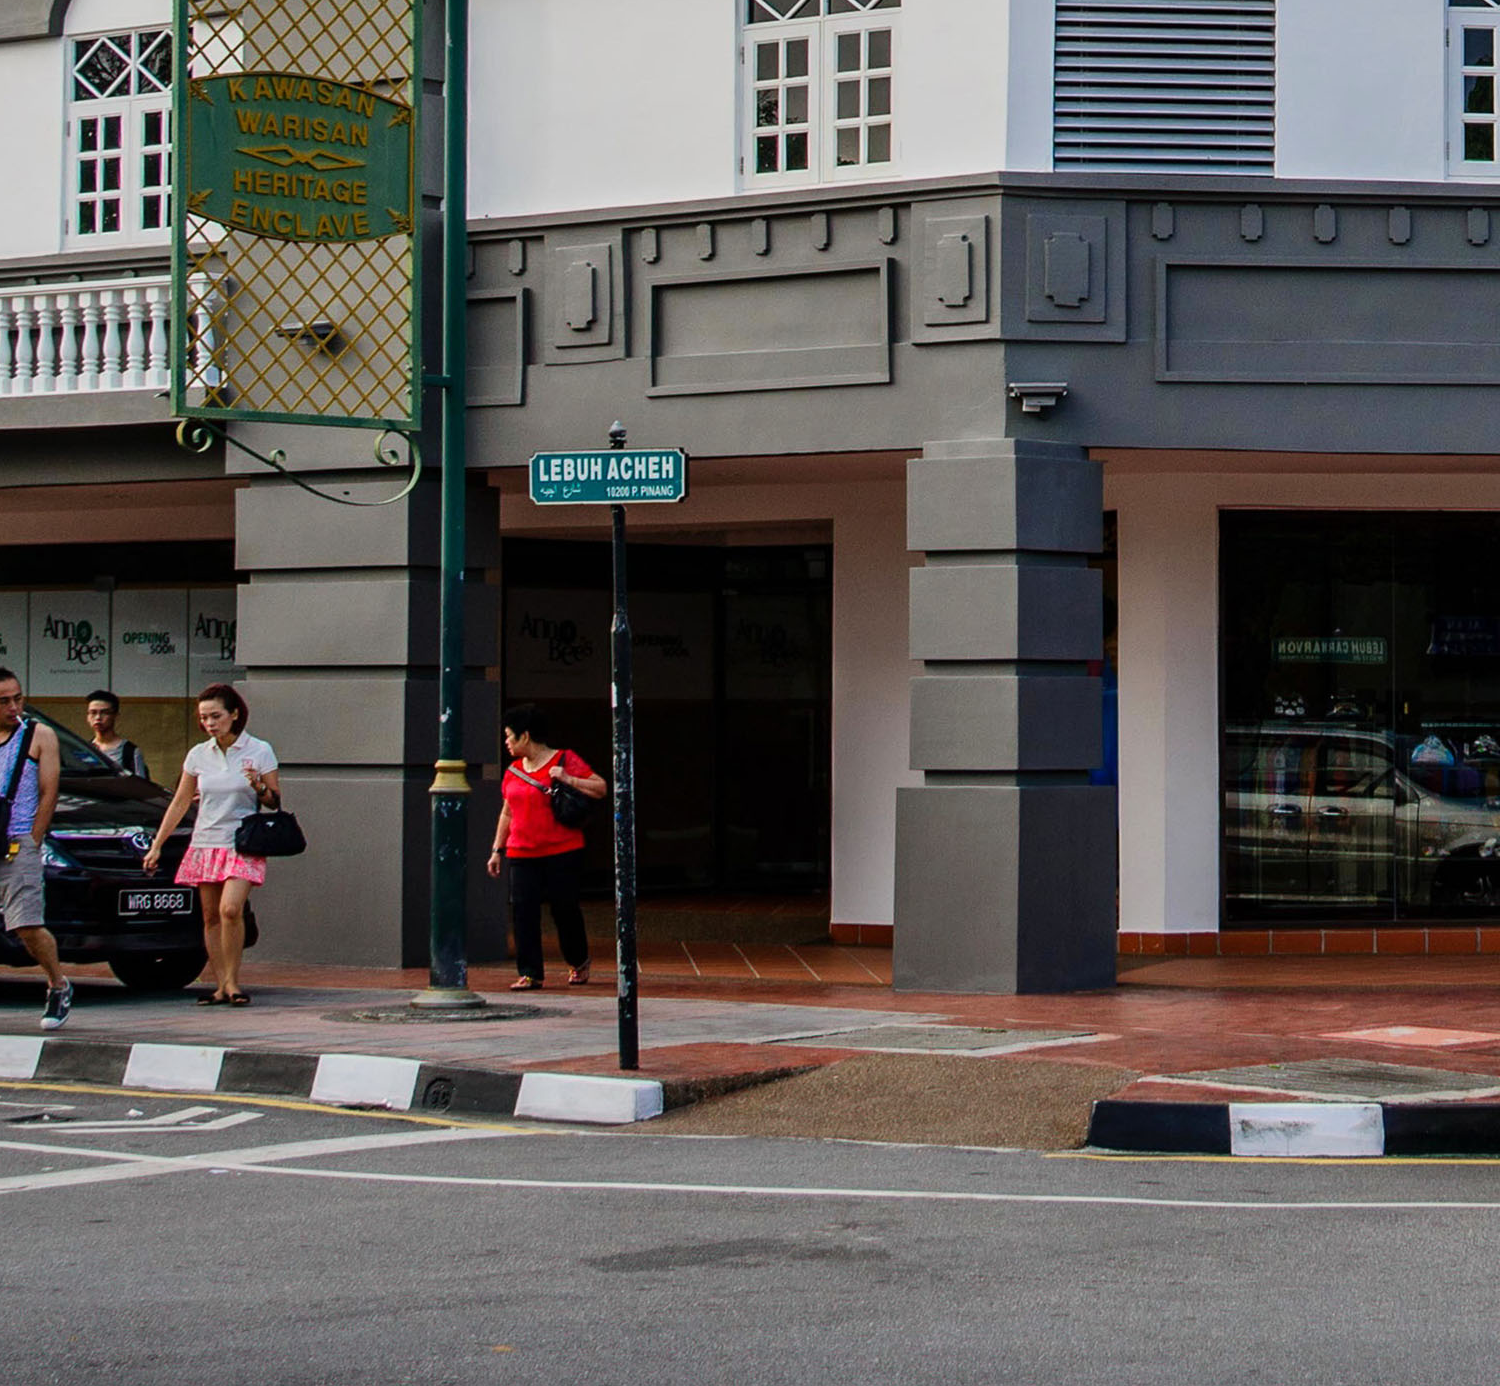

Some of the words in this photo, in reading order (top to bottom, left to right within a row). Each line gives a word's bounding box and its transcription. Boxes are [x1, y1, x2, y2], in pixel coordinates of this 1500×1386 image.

[227, 77, 377, 119] KAWASAN
[235, 108, 369, 148] WARISAN
[232, 169, 368, 205] HERITAGE
[230, 198, 370, 238] ENCLAVE
[539, 457, 602, 482] LEBUH
[606, 456, 674, 480] ACHEH
[606, 486, 630, 497] 10200
[632, 487, 639, 497] P.
[641, 485, 674, 497] PINANG
[122, 631, 170, 645] OPENING
[150, 643, 176, 655] SOON
[128, 893, 151, 910] WRG
